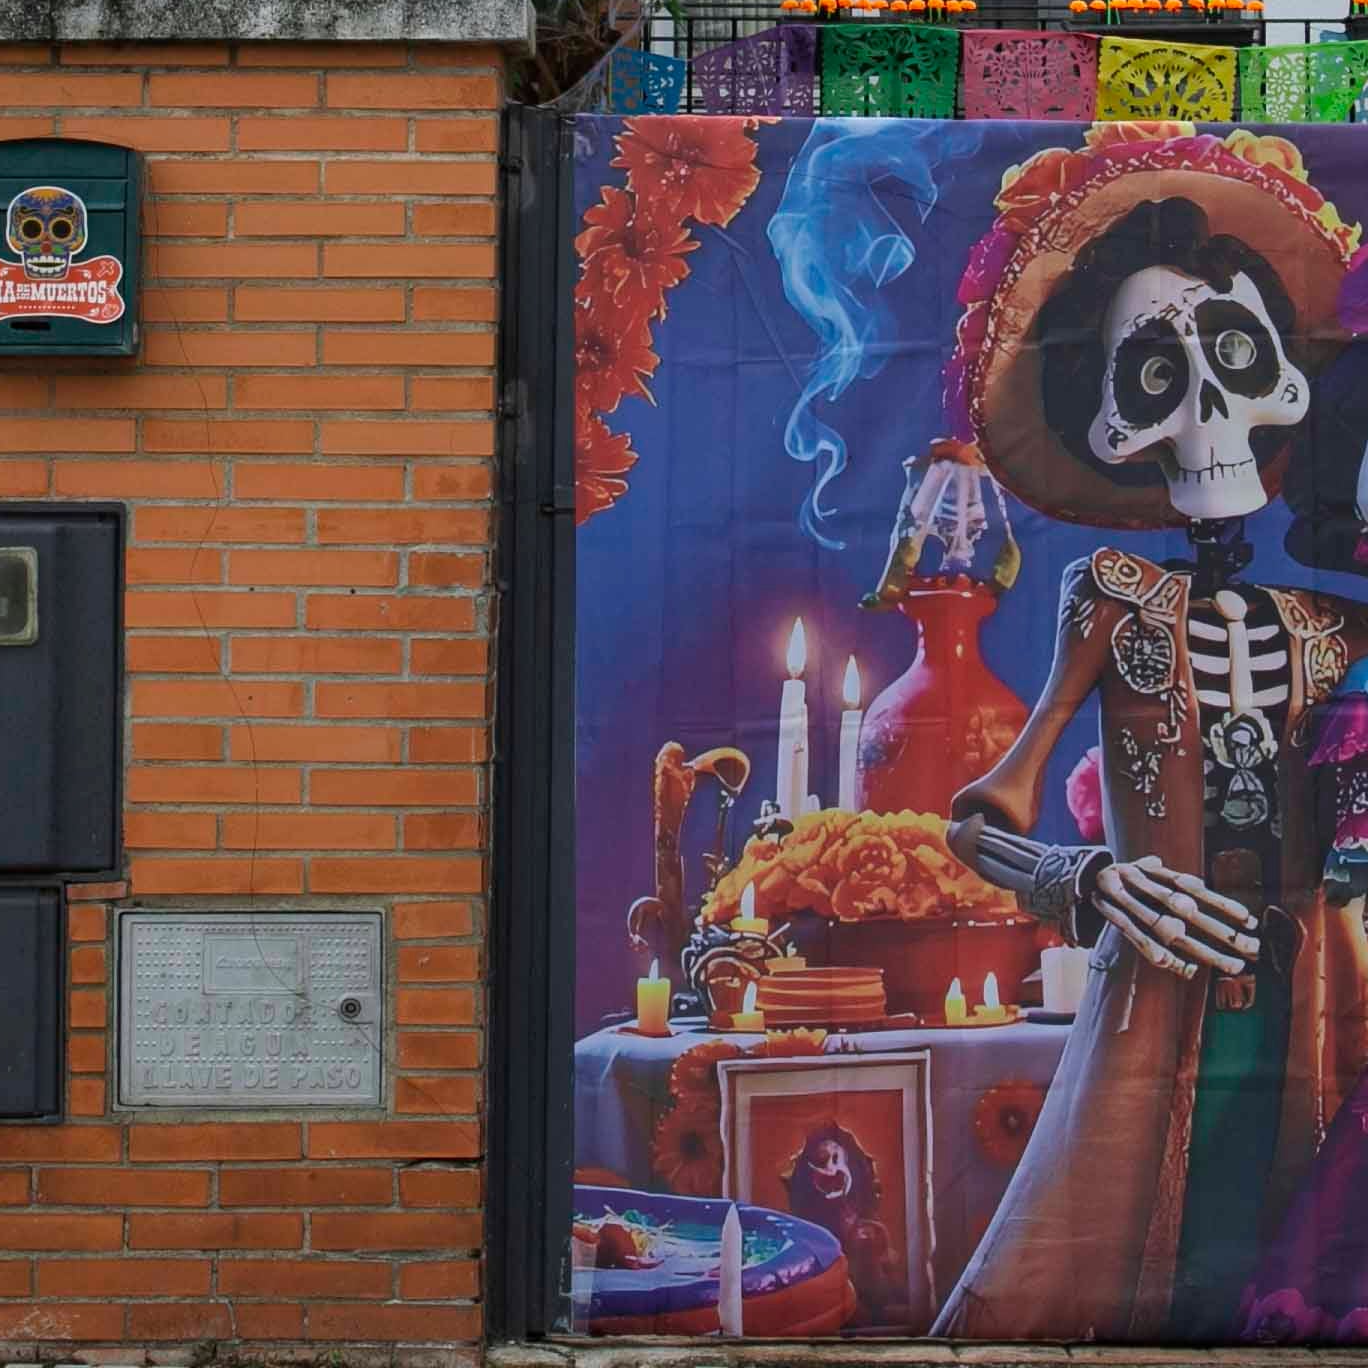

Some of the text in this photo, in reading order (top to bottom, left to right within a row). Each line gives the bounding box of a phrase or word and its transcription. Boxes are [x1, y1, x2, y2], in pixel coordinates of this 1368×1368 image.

[31, 280, 107, 304] MUERTOS
[143, 1065, 361, 1089] LLAVE DE PASO
